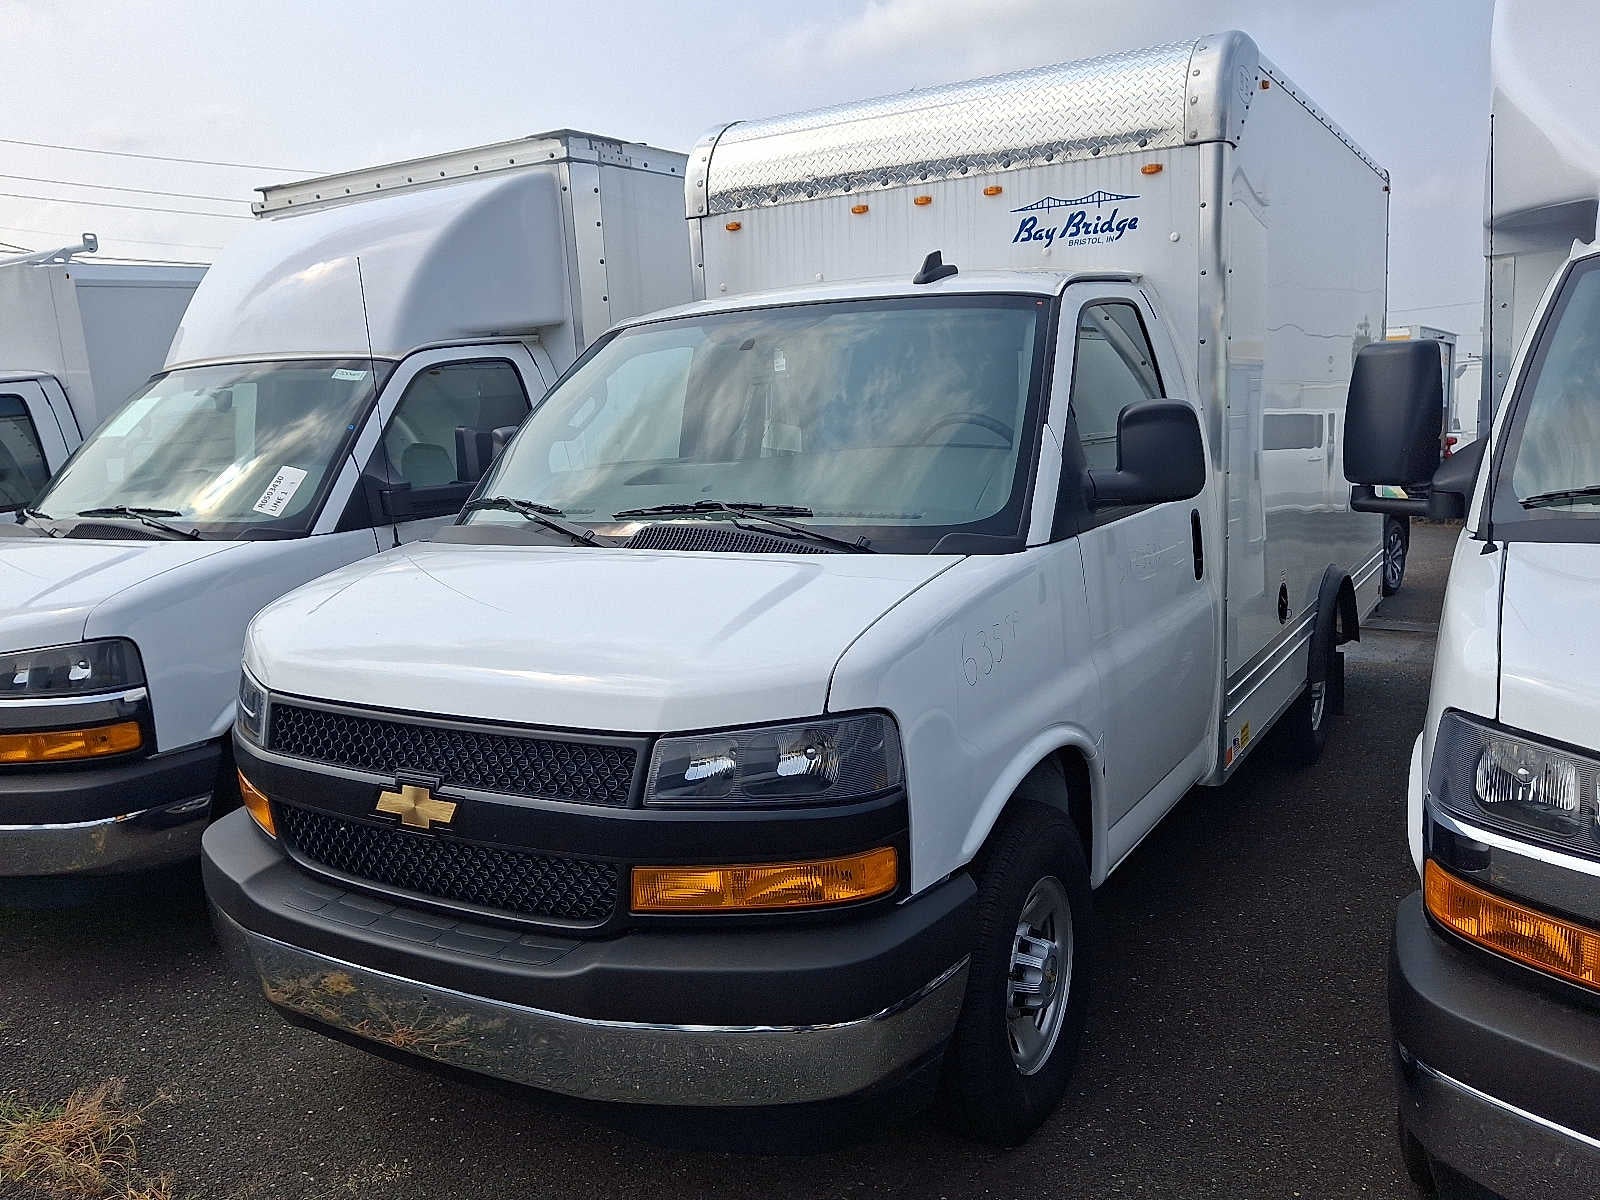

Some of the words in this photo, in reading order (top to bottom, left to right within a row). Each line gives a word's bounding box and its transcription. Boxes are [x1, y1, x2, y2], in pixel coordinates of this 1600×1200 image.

[1012, 215, 1058, 248] Bay
[1059, 208, 1139, 240] Bridge
[1068, 237, 1104, 247] BRISTOL,
[1106, 235, 1115, 243] IN
